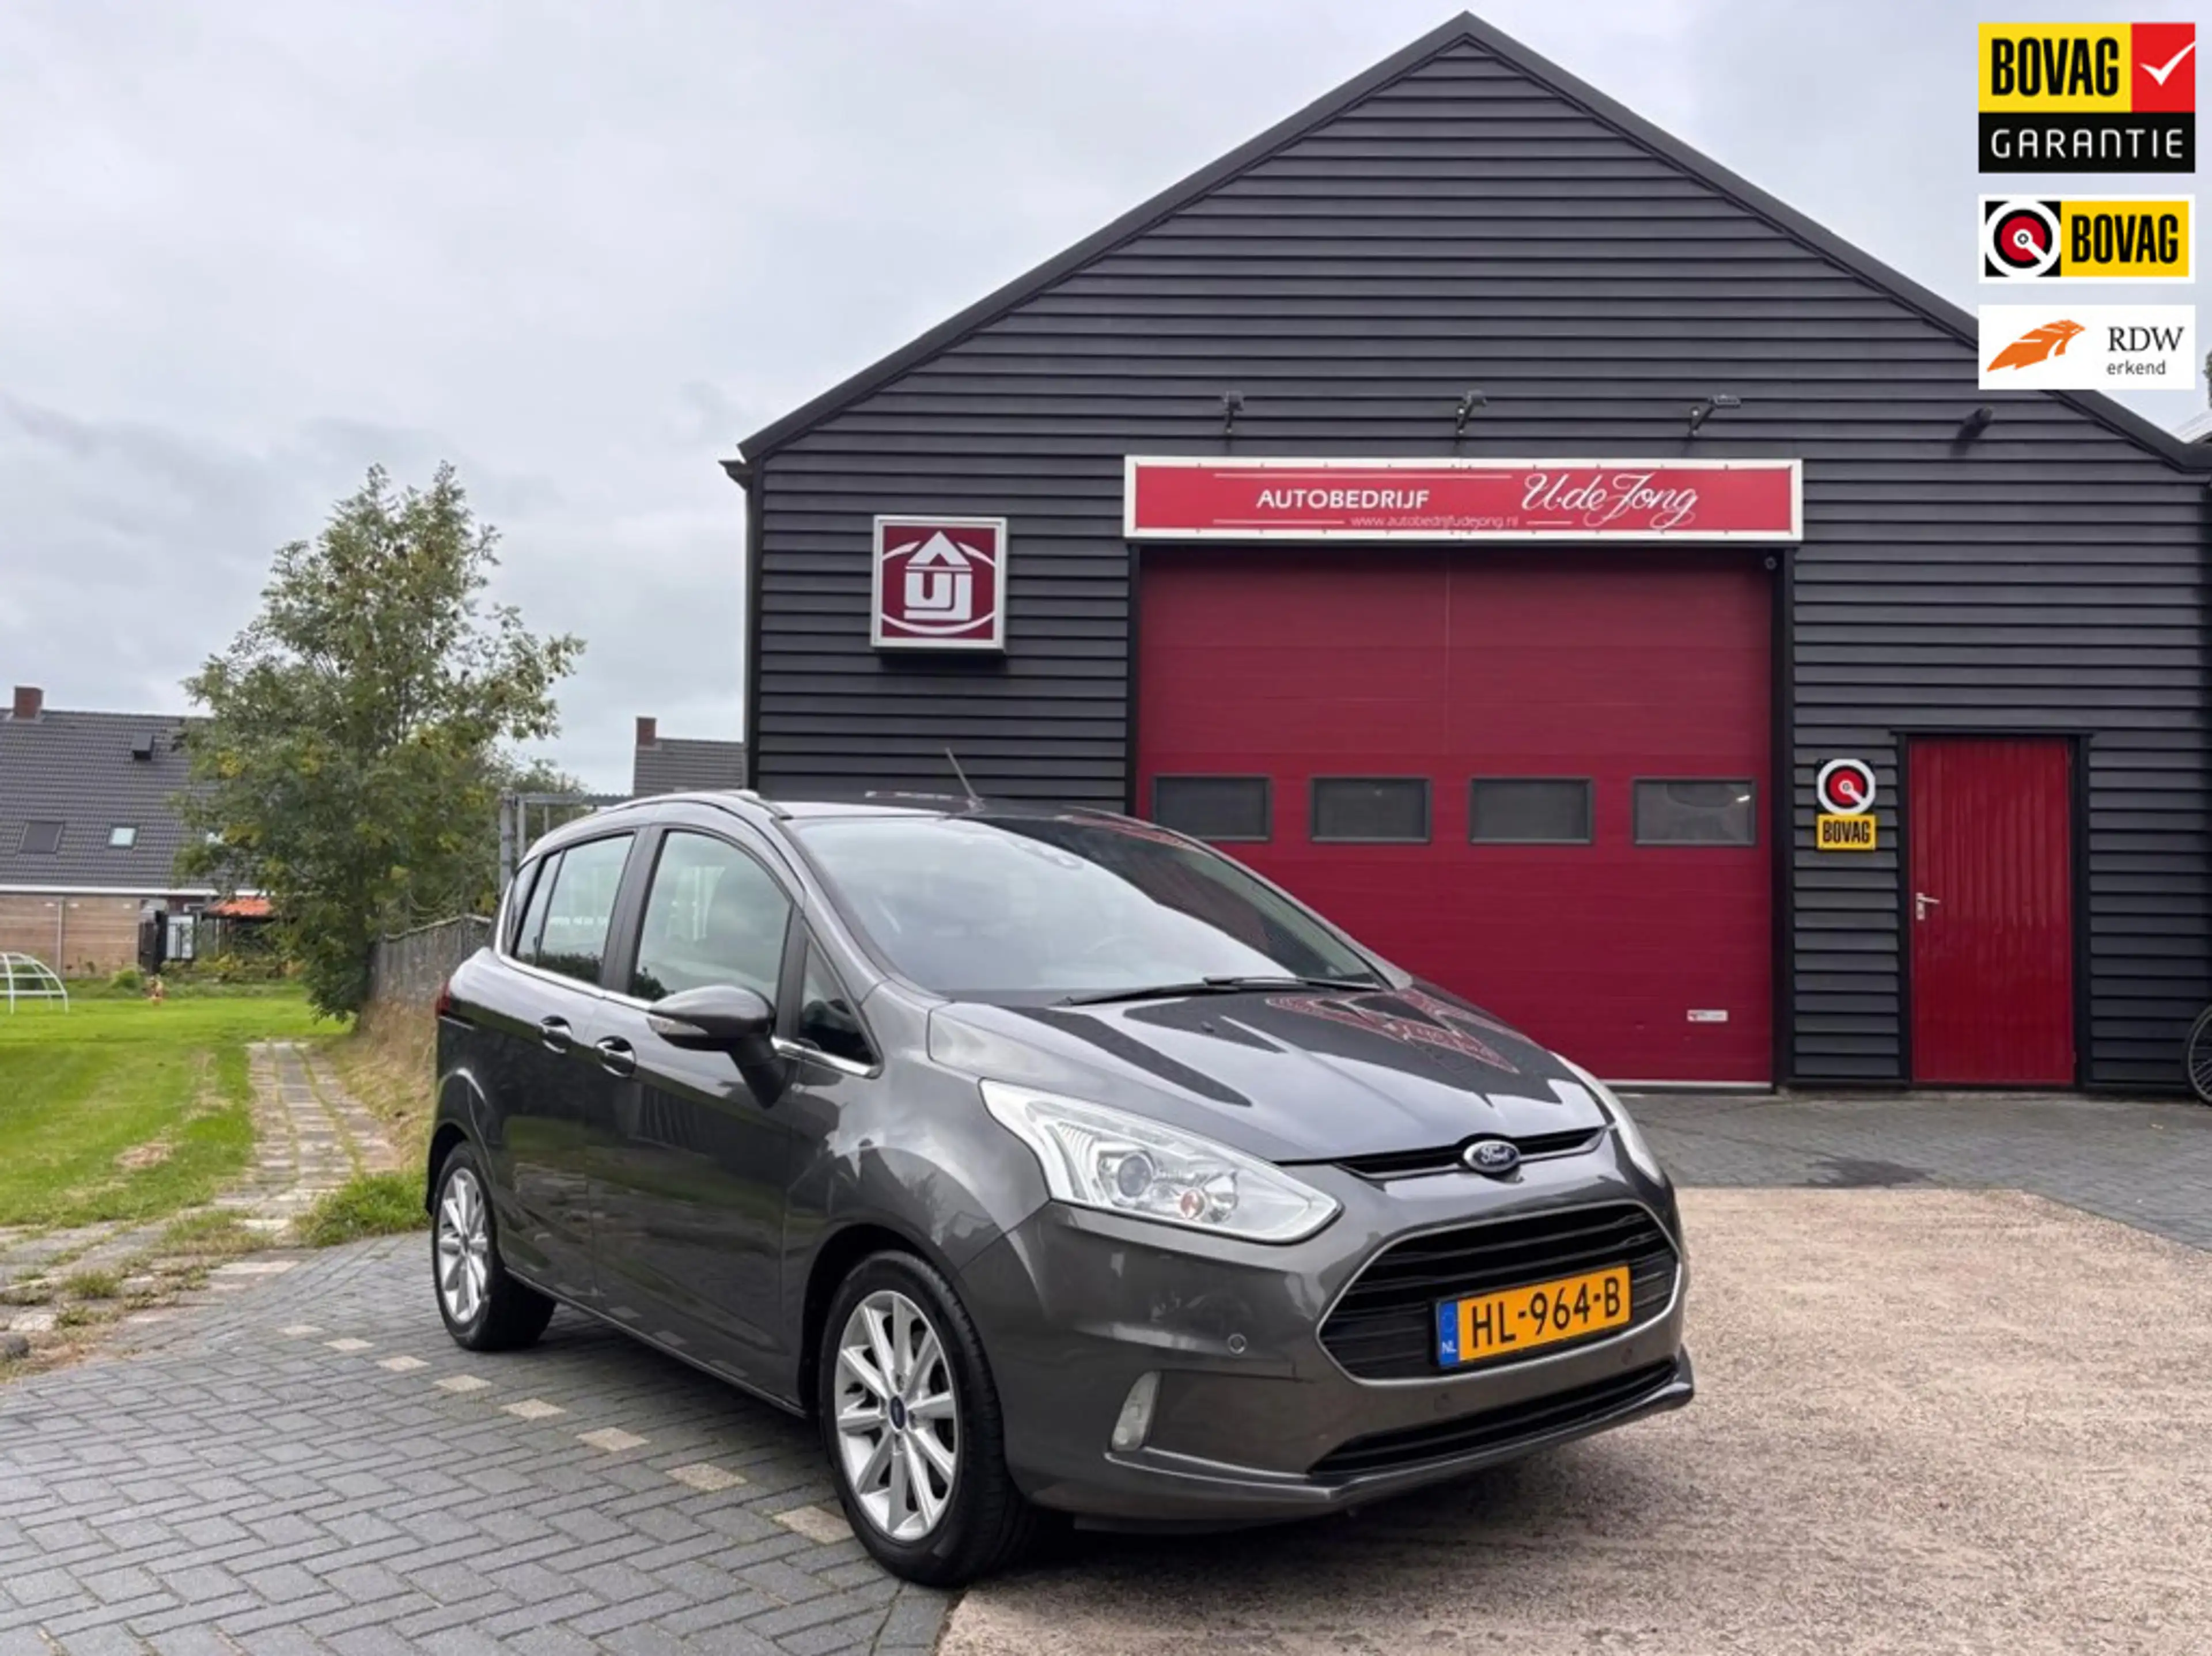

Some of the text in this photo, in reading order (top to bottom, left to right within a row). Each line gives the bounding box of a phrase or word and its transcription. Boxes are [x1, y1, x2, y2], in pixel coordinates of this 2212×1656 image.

[1256, 489, 1430, 509] AUTOBEDRIJF
[1823, 819, 1871, 844] BOVAG
[1472, 1276, 1620, 1348] HL-964-B
[1442, 1340, 1457, 1353] NL
